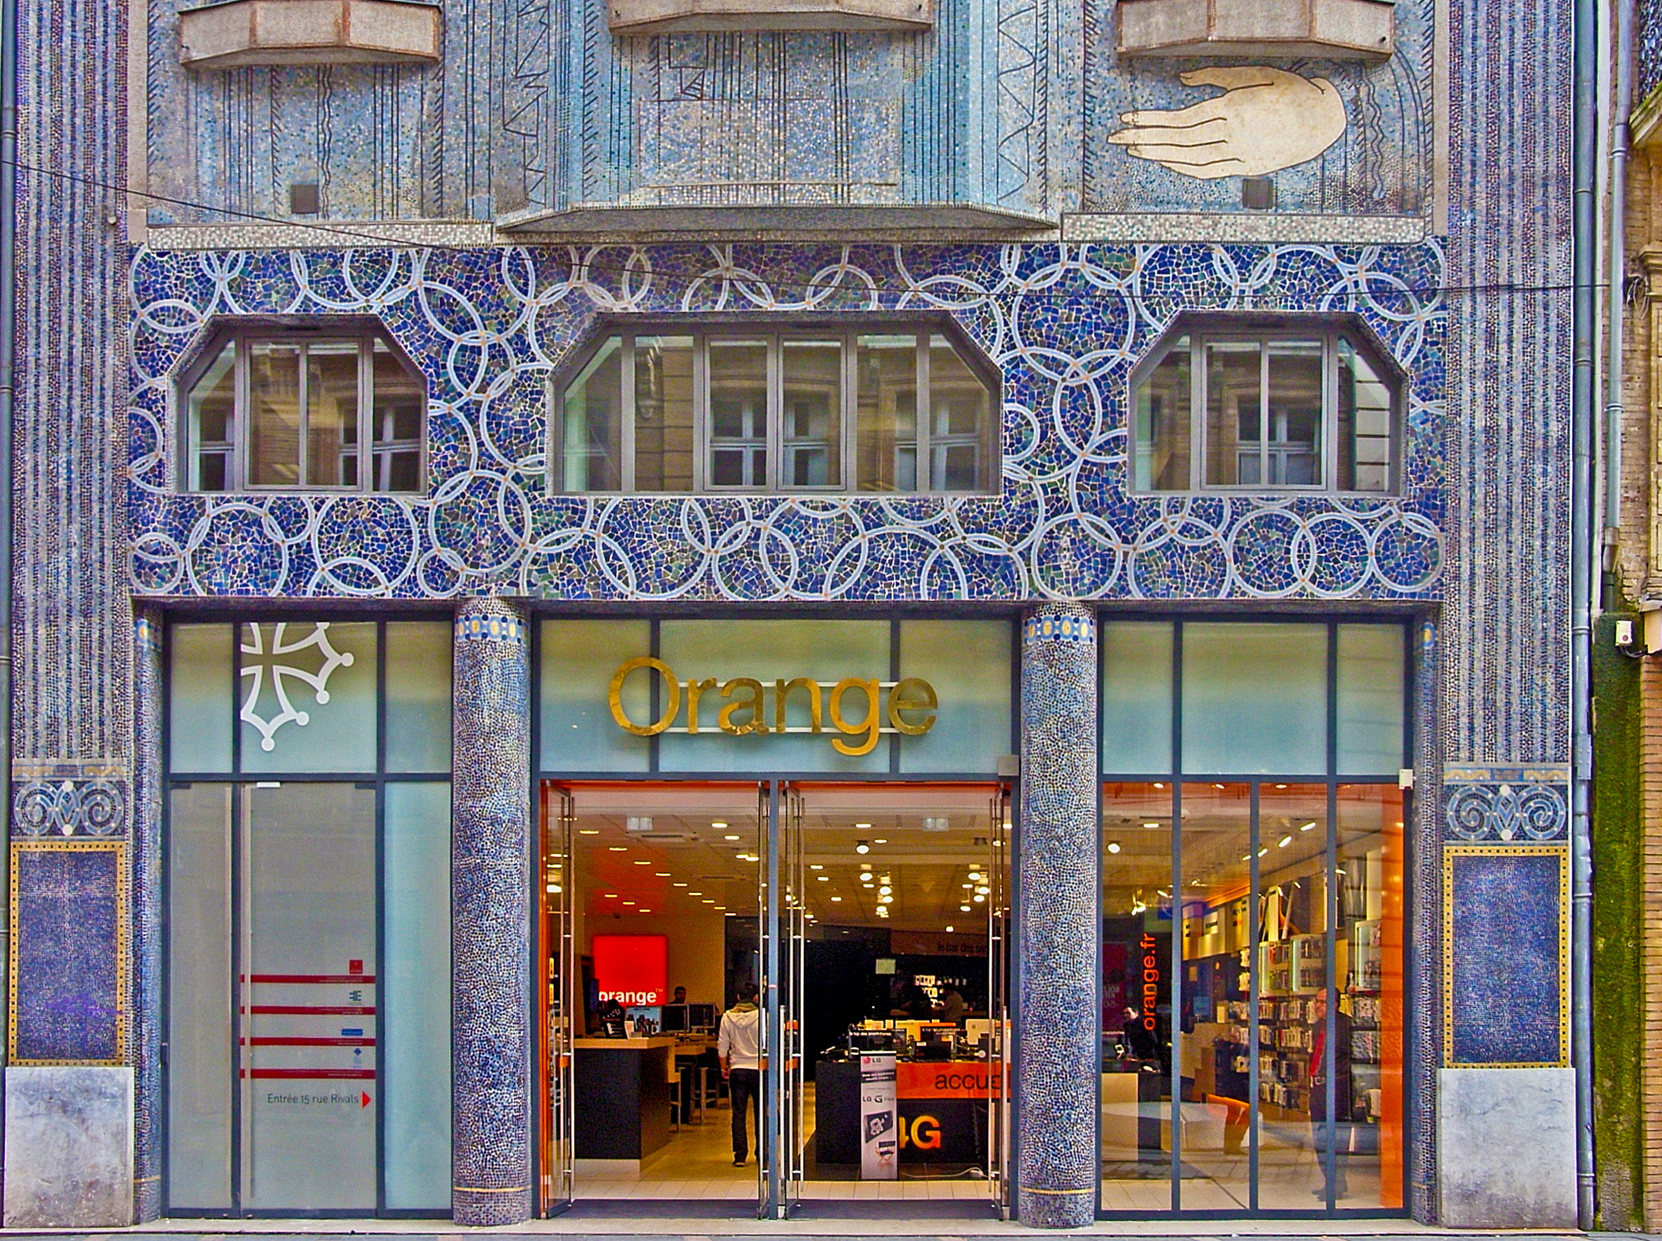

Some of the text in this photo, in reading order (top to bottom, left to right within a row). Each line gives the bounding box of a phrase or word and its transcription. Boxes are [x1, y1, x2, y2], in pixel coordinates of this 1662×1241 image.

[608, 656, 938, 757] Orange
[598, 990, 657, 1006] orange
[1140, 932, 1160, 1031] orange.fr
[267, 1093, 298, 1104] Entrée
[312, 1096, 328, 1104] rue
[331, 1093, 359, 1104] Rivals
